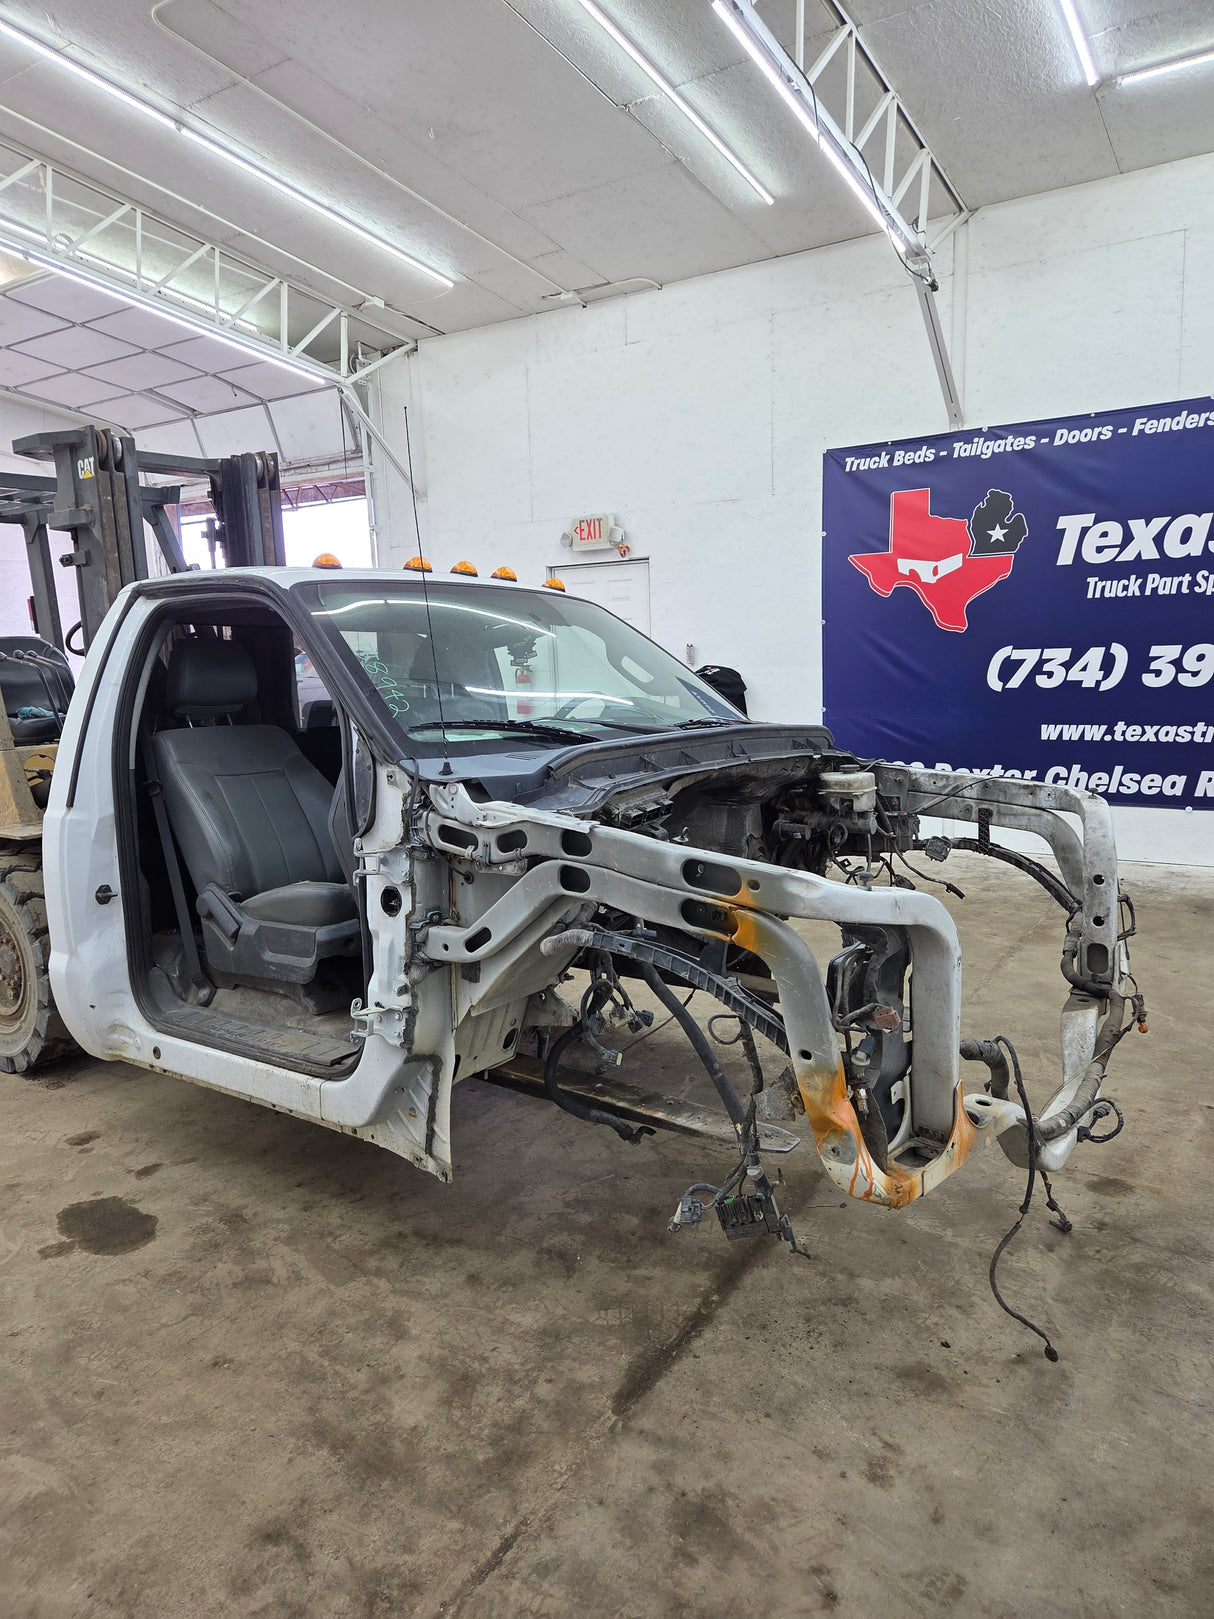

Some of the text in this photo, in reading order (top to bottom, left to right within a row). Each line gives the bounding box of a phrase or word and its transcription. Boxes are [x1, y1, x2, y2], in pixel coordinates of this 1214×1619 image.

[845, 447, 889, 472] Truck
[893, 446, 935, 467] Beds
[952, 433, 1036, 459] Tailgates
[1054, 424, 1113, 447] Doors
[1132, 410, 1214, 436] Fenders
[77, 456, 96, 480] CAT
[578, 517, 603, 541] EXIT
[1056, 512, 1214, 566] Texa
[1086, 574, 1143, 599] Truck
[1144, 572, 1192, 596] Part
[986, 642, 1214, 692] (734) 39
[1044, 764, 1187, 798] Chelsea
[1193, 770, 1214, 798] R
